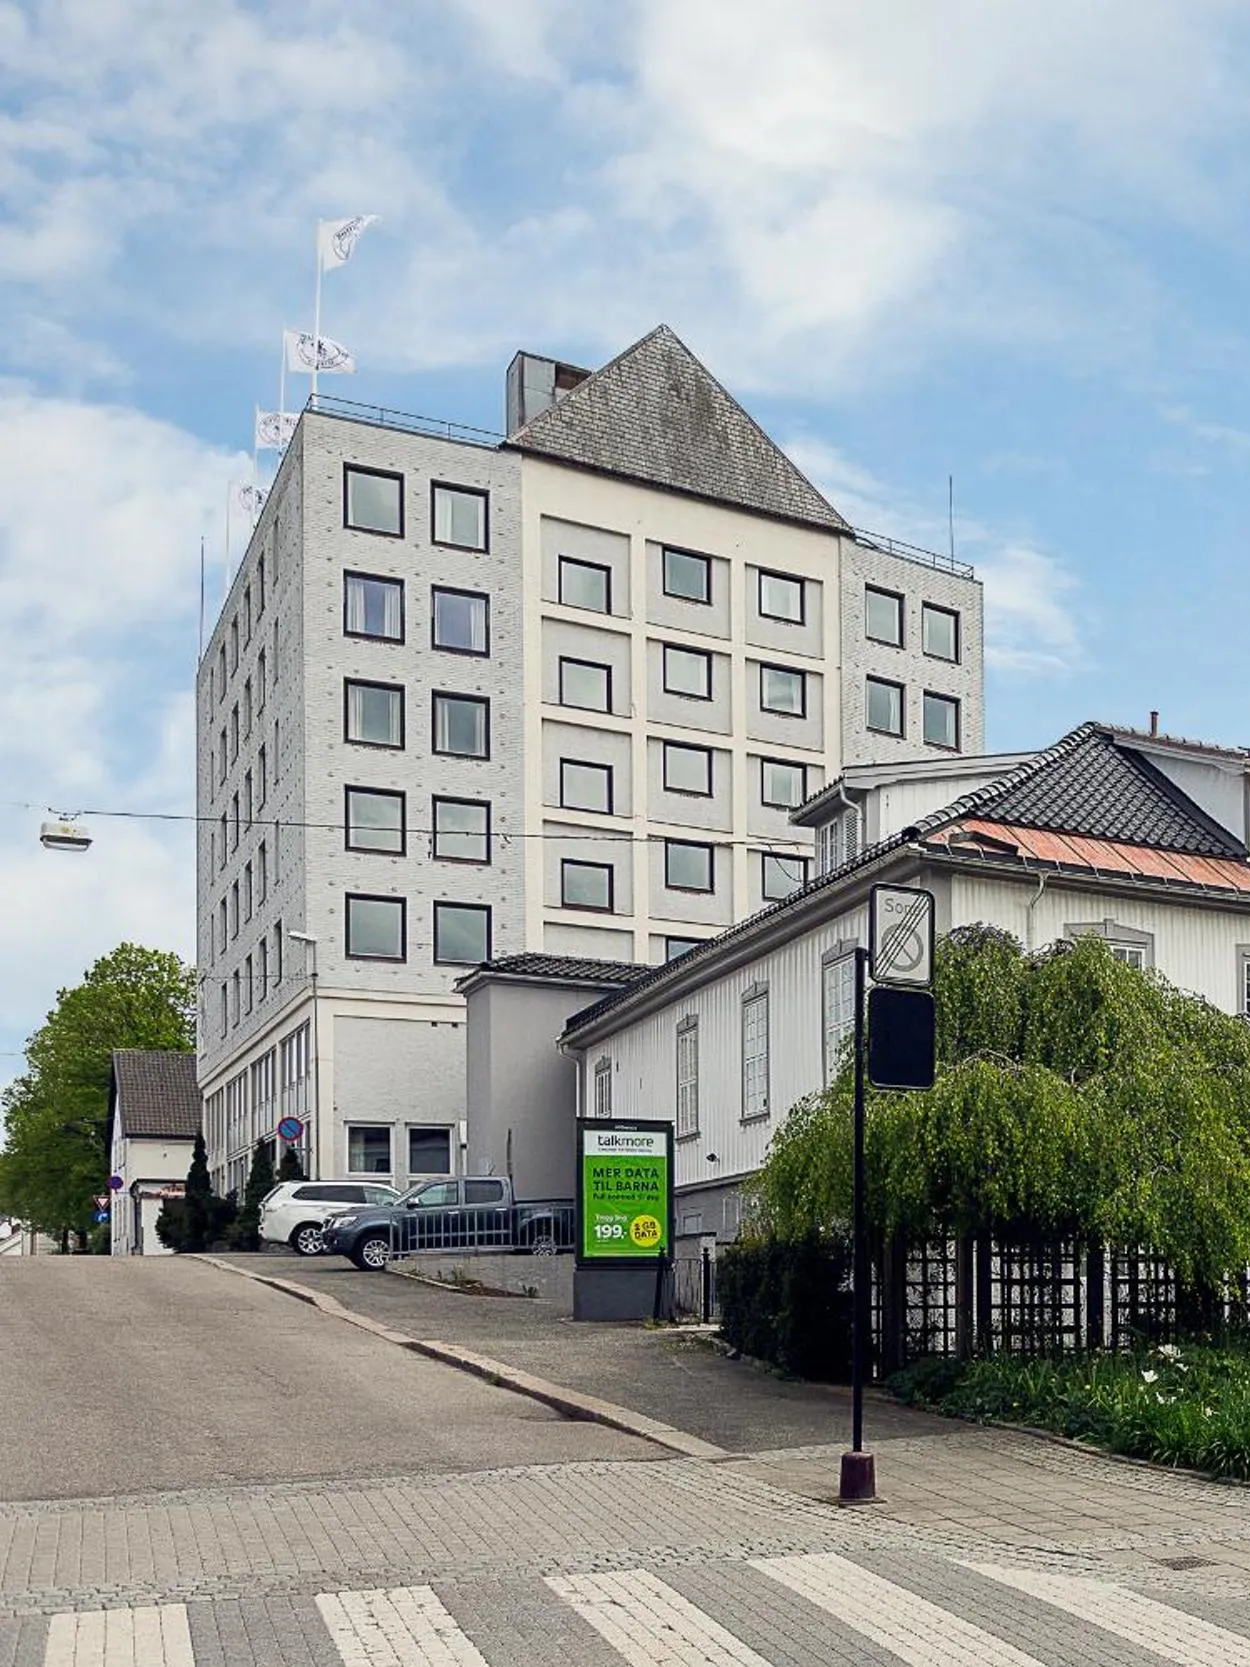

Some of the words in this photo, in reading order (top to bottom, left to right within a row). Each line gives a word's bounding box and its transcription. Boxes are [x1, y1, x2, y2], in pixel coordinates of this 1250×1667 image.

[597, 1134, 654, 1147] talkmore
[593, 1167, 621, 1178] MER
[625, 1168, 660, 1179] DATA
[593, 1181, 613, 1191] TIL
[616, 1181, 659, 1192] BARNA
[634, 1229, 659, 1239] DATA
